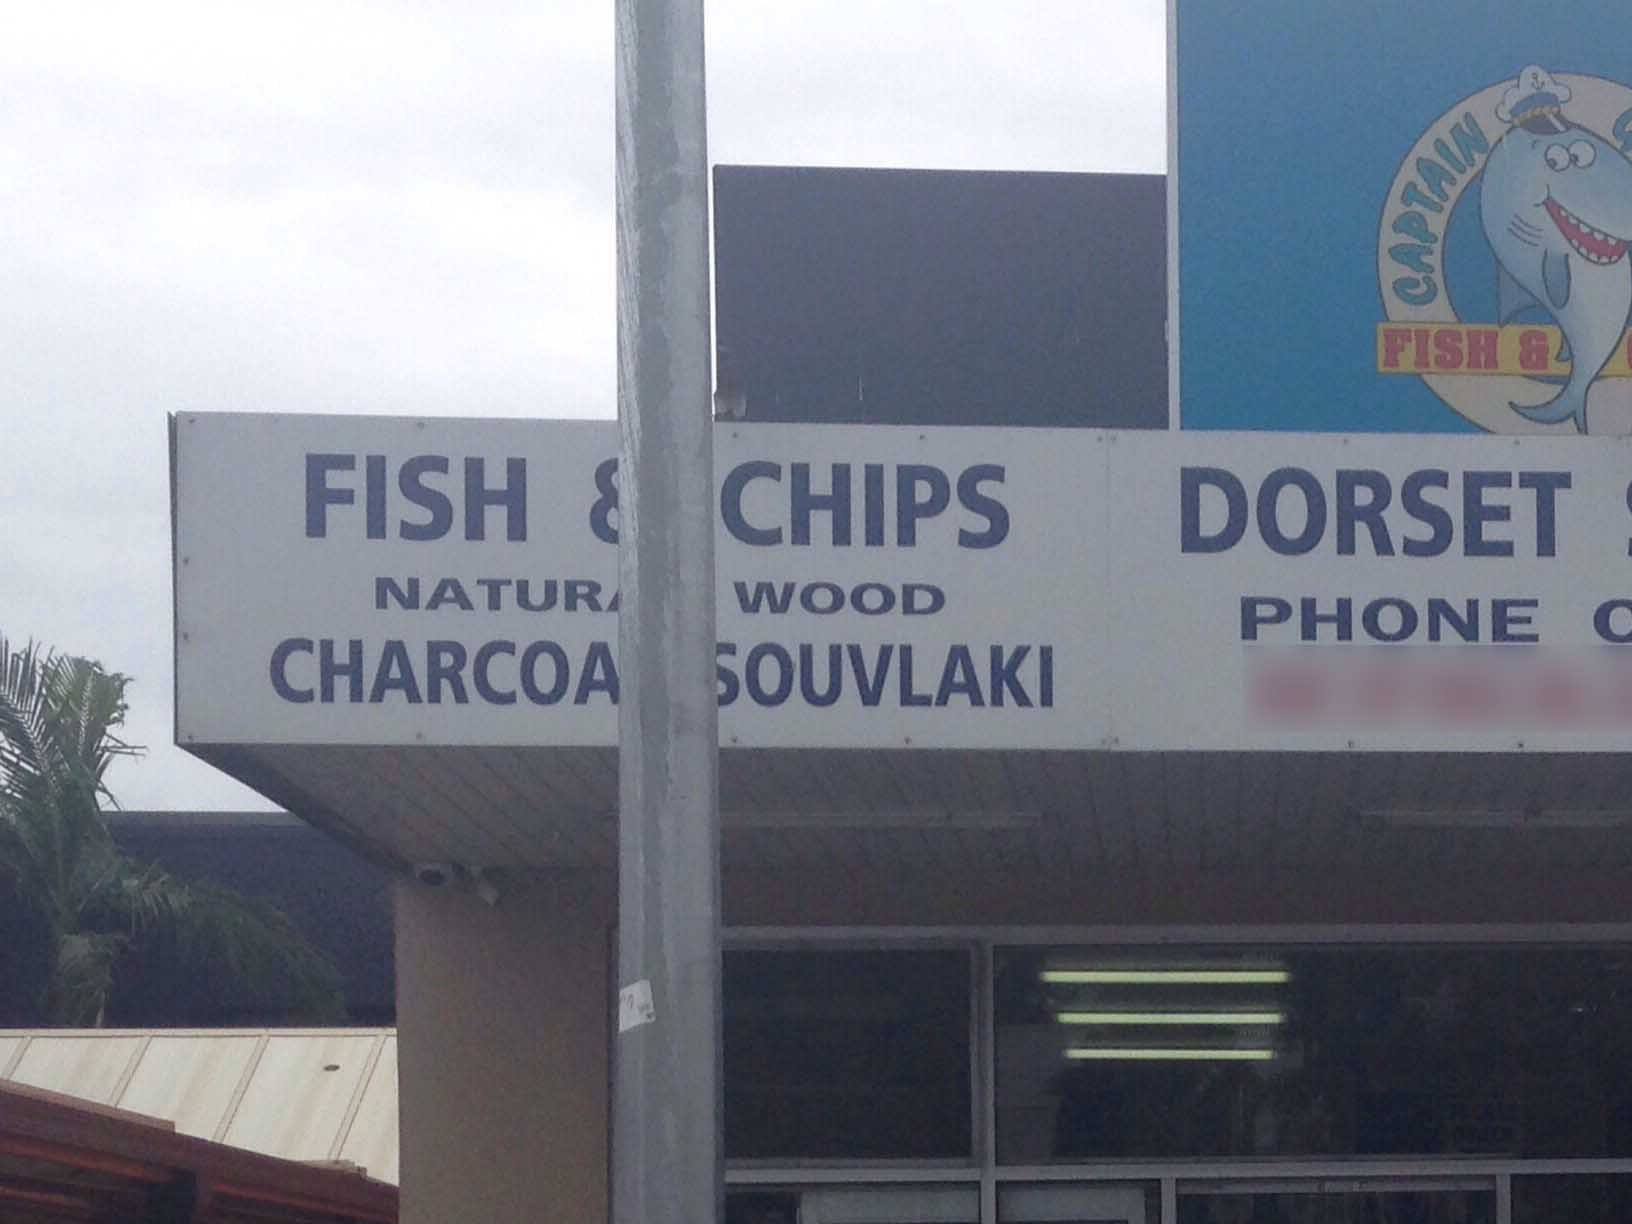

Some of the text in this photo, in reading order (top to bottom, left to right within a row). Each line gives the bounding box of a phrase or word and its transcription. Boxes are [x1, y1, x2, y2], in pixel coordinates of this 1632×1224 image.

[1388, 110, 1490, 305] CAPTAIN
[1383, 327, 1499, 371] FISH
[1518, 329, 1550, 371] &
[305, 453, 528, 543] FISH
[719, 460, 1011, 550] CHIPS
[1180, 466, 1573, 558] DORSET
[374, 577, 947, 616] NATUR WOOD
[1240, 596, 1540, 643] PHONE
[269, 637, 1055, 708] CHARCOA SOUVLAKI
